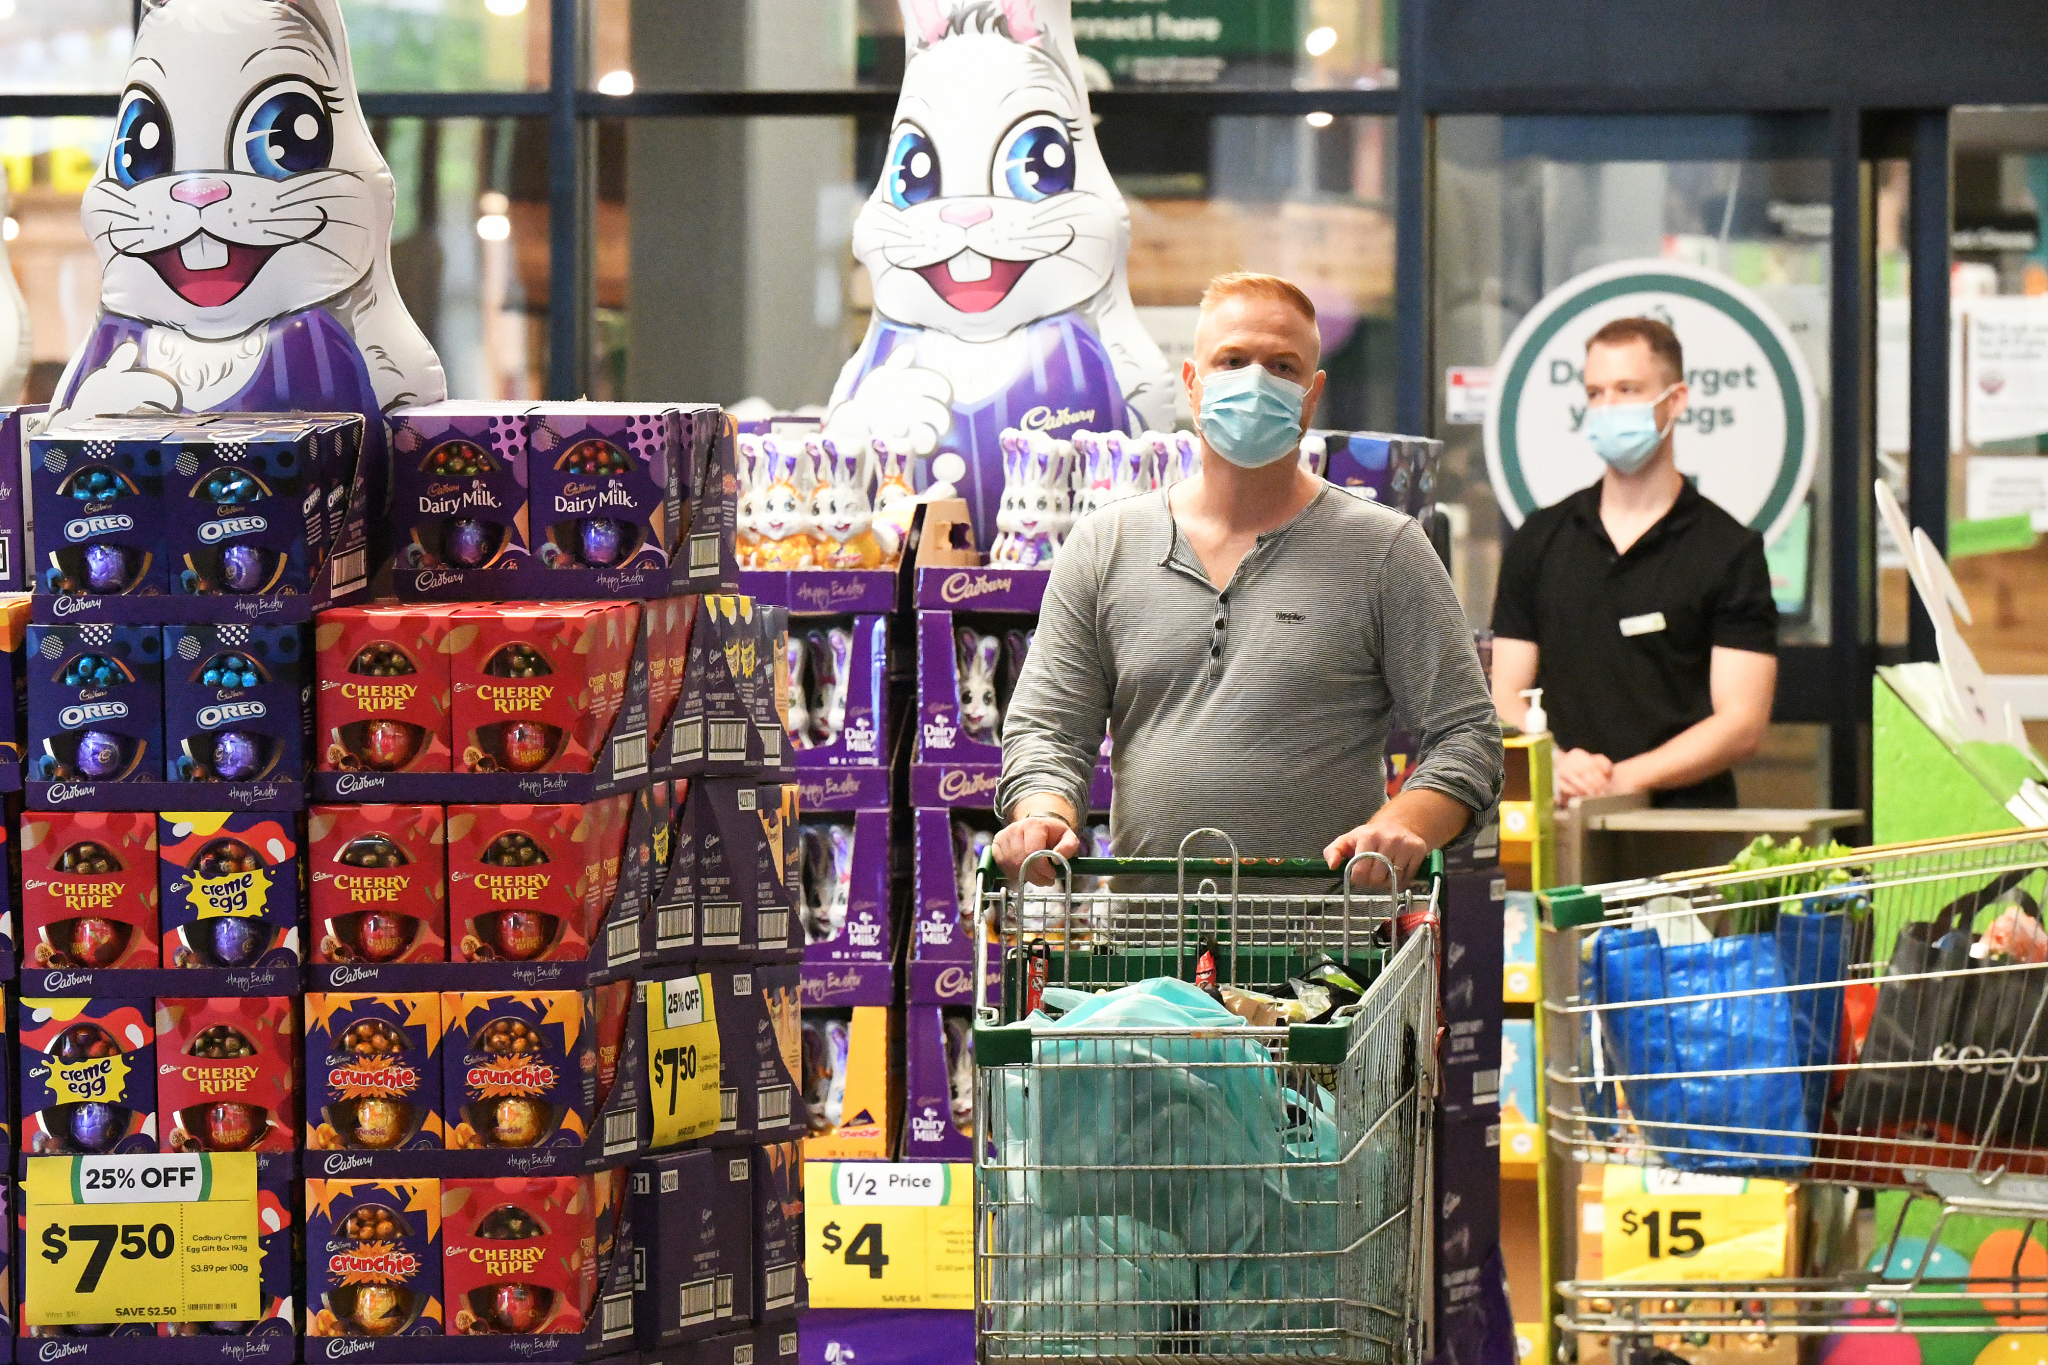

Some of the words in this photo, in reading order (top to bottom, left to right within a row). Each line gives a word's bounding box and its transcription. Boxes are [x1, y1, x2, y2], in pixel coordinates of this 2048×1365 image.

[1689, 365, 1757, 395] rget
[1020, 405, 1095, 431] Cadbury
[1679, 404, 1735, 433] ags
[419, 496, 461, 514] Dairy
[463, 486, 502, 507] Milk
[555, 495, 597, 513] Dairy
[599, 486, 638, 507] Milk
[66, 516, 132, 540] OREO
[199, 517, 266, 541] OREO
[415, 571, 464, 592] Cadbury
[596, 573, 620, 592] Happy
[620, 572, 645, 586] Easter
[941, 572, 1012, 603] Cadbury
[53, 596, 102, 616] Cadbury
[234, 599, 259, 617] Happy
[259, 597, 285, 612] Easter
[341, 683, 418, 699] CHERRY
[476, 685, 554, 700] CHERRY
[60, 702, 128, 727] OREO
[358, 697, 406, 712] RIPE
[494, 698, 543, 713] RIPE
[197, 702, 266, 728] OREO
[845, 727, 878, 743] Dairy
[923, 724, 957, 740] Dairy
[925, 736, 955, 748] Milk
[846, 739, 876, 752] Milk
[47, 783, 96, 803] Cadbury
[336, 774, 385, 795] Cadbury
[518, 778, 542, 797] Happy
[543, 775, 569, 789] Easter
[229, 788, 253, 806] Happy
[253, 786, 279, 800] Easter
[48, 881, 125, 897] CHERRY
[201, 873, 254, 896] creme
[333, 874, 410, 891] CHERRY
[474, 873, 551, 890] CHERRY
[65, 895, 114, 910] RIPE
[209, 890, 249, 913] egg
[350, 888, 399, 904] RIPE
[491, 887, 540, 903] RIPE
[848, 921, 881, 937] Dairy
[920, 921, 954, 937] Dairy
[922, 933, 952, 945] Milk
[849, 933, 880, 946] Milk
[43, 971, 92, 992] Cadbury
[226, 974, 250, 992] Happy
[250, 972, 276, 986] Easter
[330, 966, 379, 987] Cadbury
[512, 966, 537, 986] Happy
[537, 963, 562, 977] Easter
[668, 994, 685, 1014] 25%
[684, 989, 700, 1009] OFF
[60, 1059, 112, 1081] creme
[182, 1066, 259, 1081] CHERRY
[329, 1067, 415, 1090] crunchie
[467, 1065, 554, 1088] crunchie
[68, 1076, 106, 1098] egg
[200, 1079, 248, 1094] RIPE
[912, 1117, 946, 1133] Dairy
[913, 1130, 945, 1142] Milk
[324, 1153, 373, 1174] Cadbury
[507, 1154, 532, 1173] Happy
[532, 1152, 557, 1166] Easter
[86, 1167, 136, 1190] 25%
[141, 1166, 196, 1188] OFF
[846, 1172, 877, 1196] 1/2
[888, 1173, 931, 1188] Price
[192, 1234, 222, 1242] Cadbury
[1621, 1209, 1705, 1259] $15
[231, 1244, 248, 1252] 193g
[469, 1247, 546, 1263] CHERRY
[822, 1221, 889, 1279] $4
[190, 1264, 214, 1273] $3.89
[229, 1264, 248, 1273] 100g
[329, 1253, 416, 1276] crunchie
[486, 1260, 535, 1276] RIPE
[882, 1295, 909, 1303] SAVE
[115, 1307, 146, 1317] SAVE
[147, 1306, 177, 1318] $2.50
[39, 1341, 88, 1363] Cadbury
[221, 1342, 246, 1361] Happy
[246, 1340, 271, 1354] Easter
[326, 1338, 375, 1359] Cadbury
[509, 1339, 533, 1358] Happy
[534, 1335, 560, 1349] Easter
